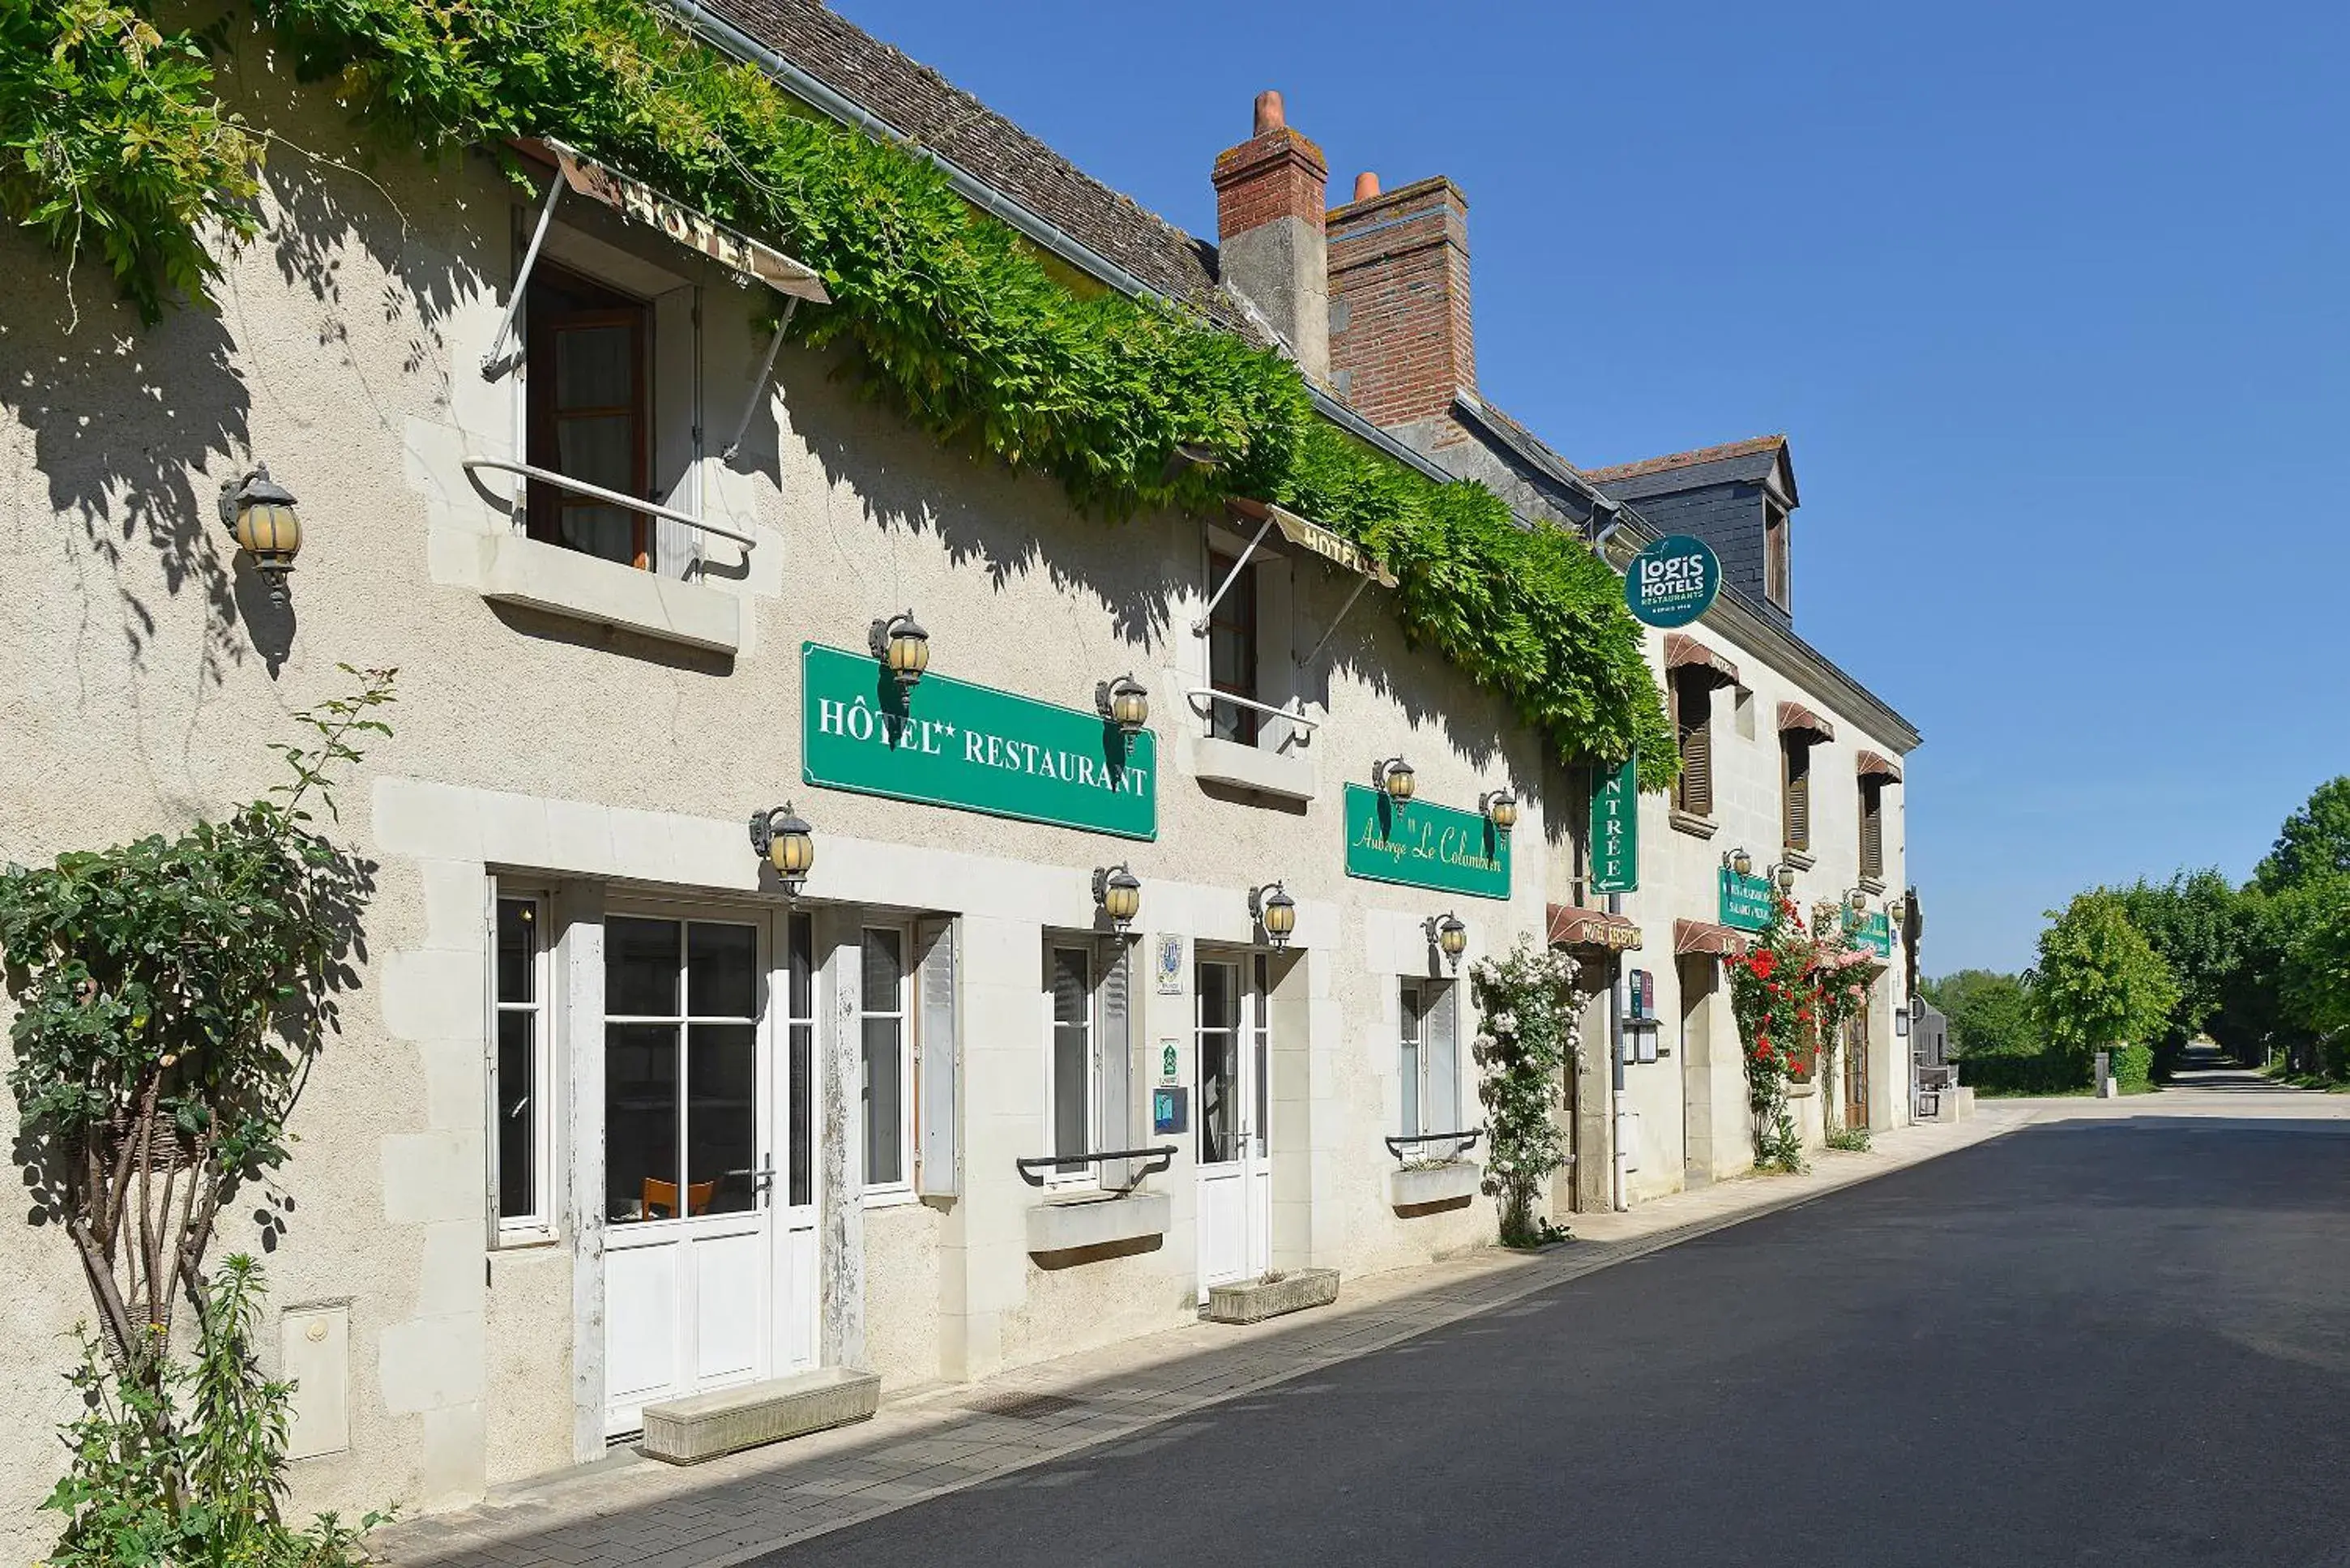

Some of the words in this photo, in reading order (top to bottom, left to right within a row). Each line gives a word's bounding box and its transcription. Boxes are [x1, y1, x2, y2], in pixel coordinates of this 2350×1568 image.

[1641, 576, 1703, 597] HOTELS
[1641, 591, 1703, 605] RESTAURANTS
[818, 694, 941, 754] HÔTEL
[963, 729, 1147, 797] RESTAURANT
[1352, 817, 1407, 864] Auberge
